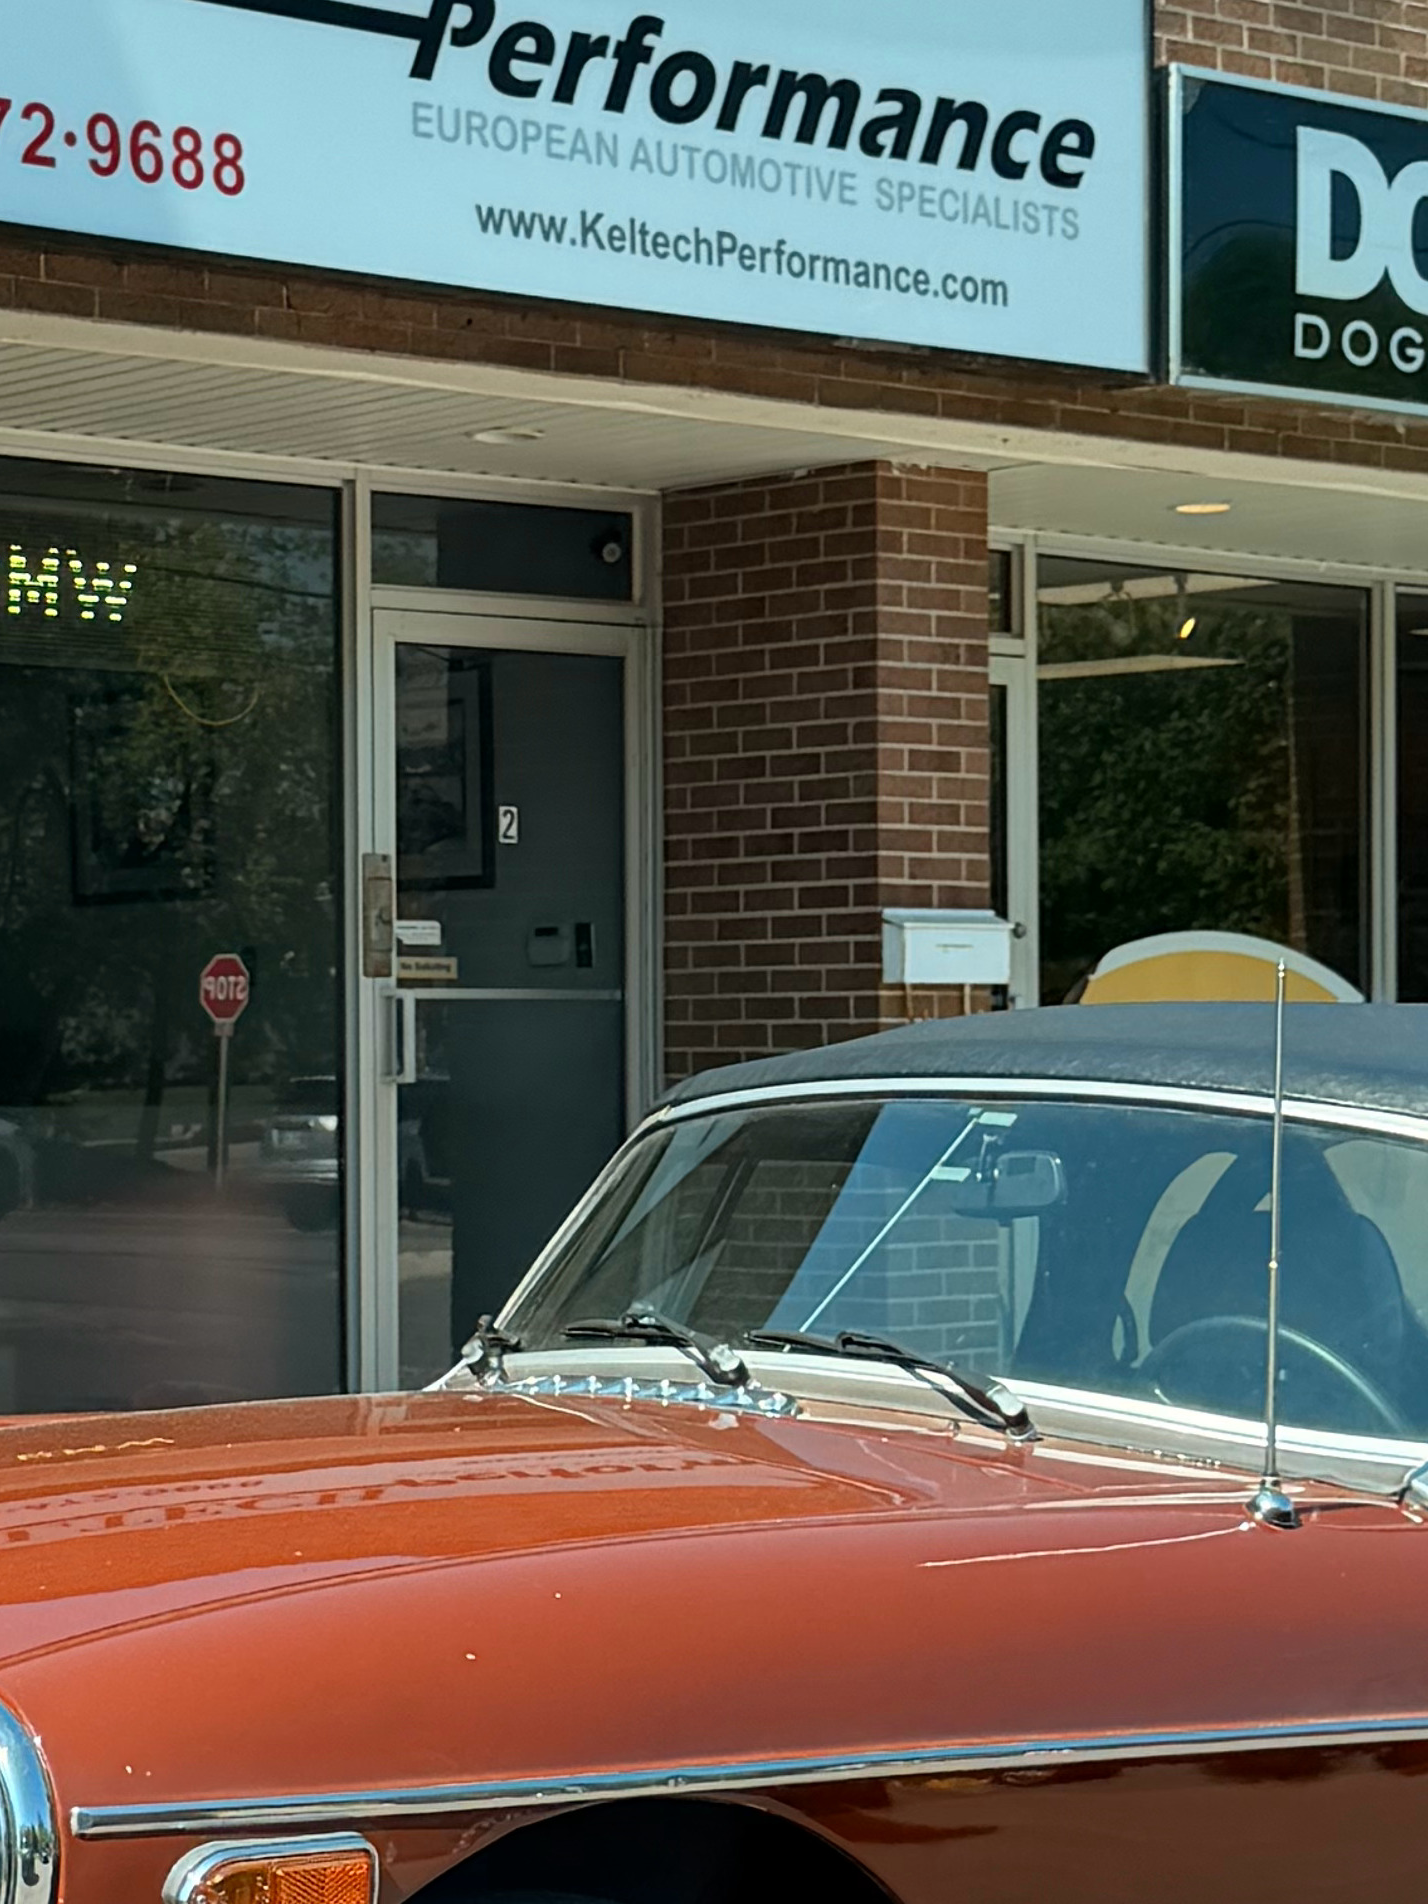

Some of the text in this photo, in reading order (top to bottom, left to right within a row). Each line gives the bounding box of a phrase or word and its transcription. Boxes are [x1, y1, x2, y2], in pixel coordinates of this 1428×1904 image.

[410, 100, 1080, 240] EUROPEAN AUTOMOTIVE SPECIALISTS
[475, 202, 1009, 308] www.KeltechPerformance.com
[501, 808, 516, 841] 2
